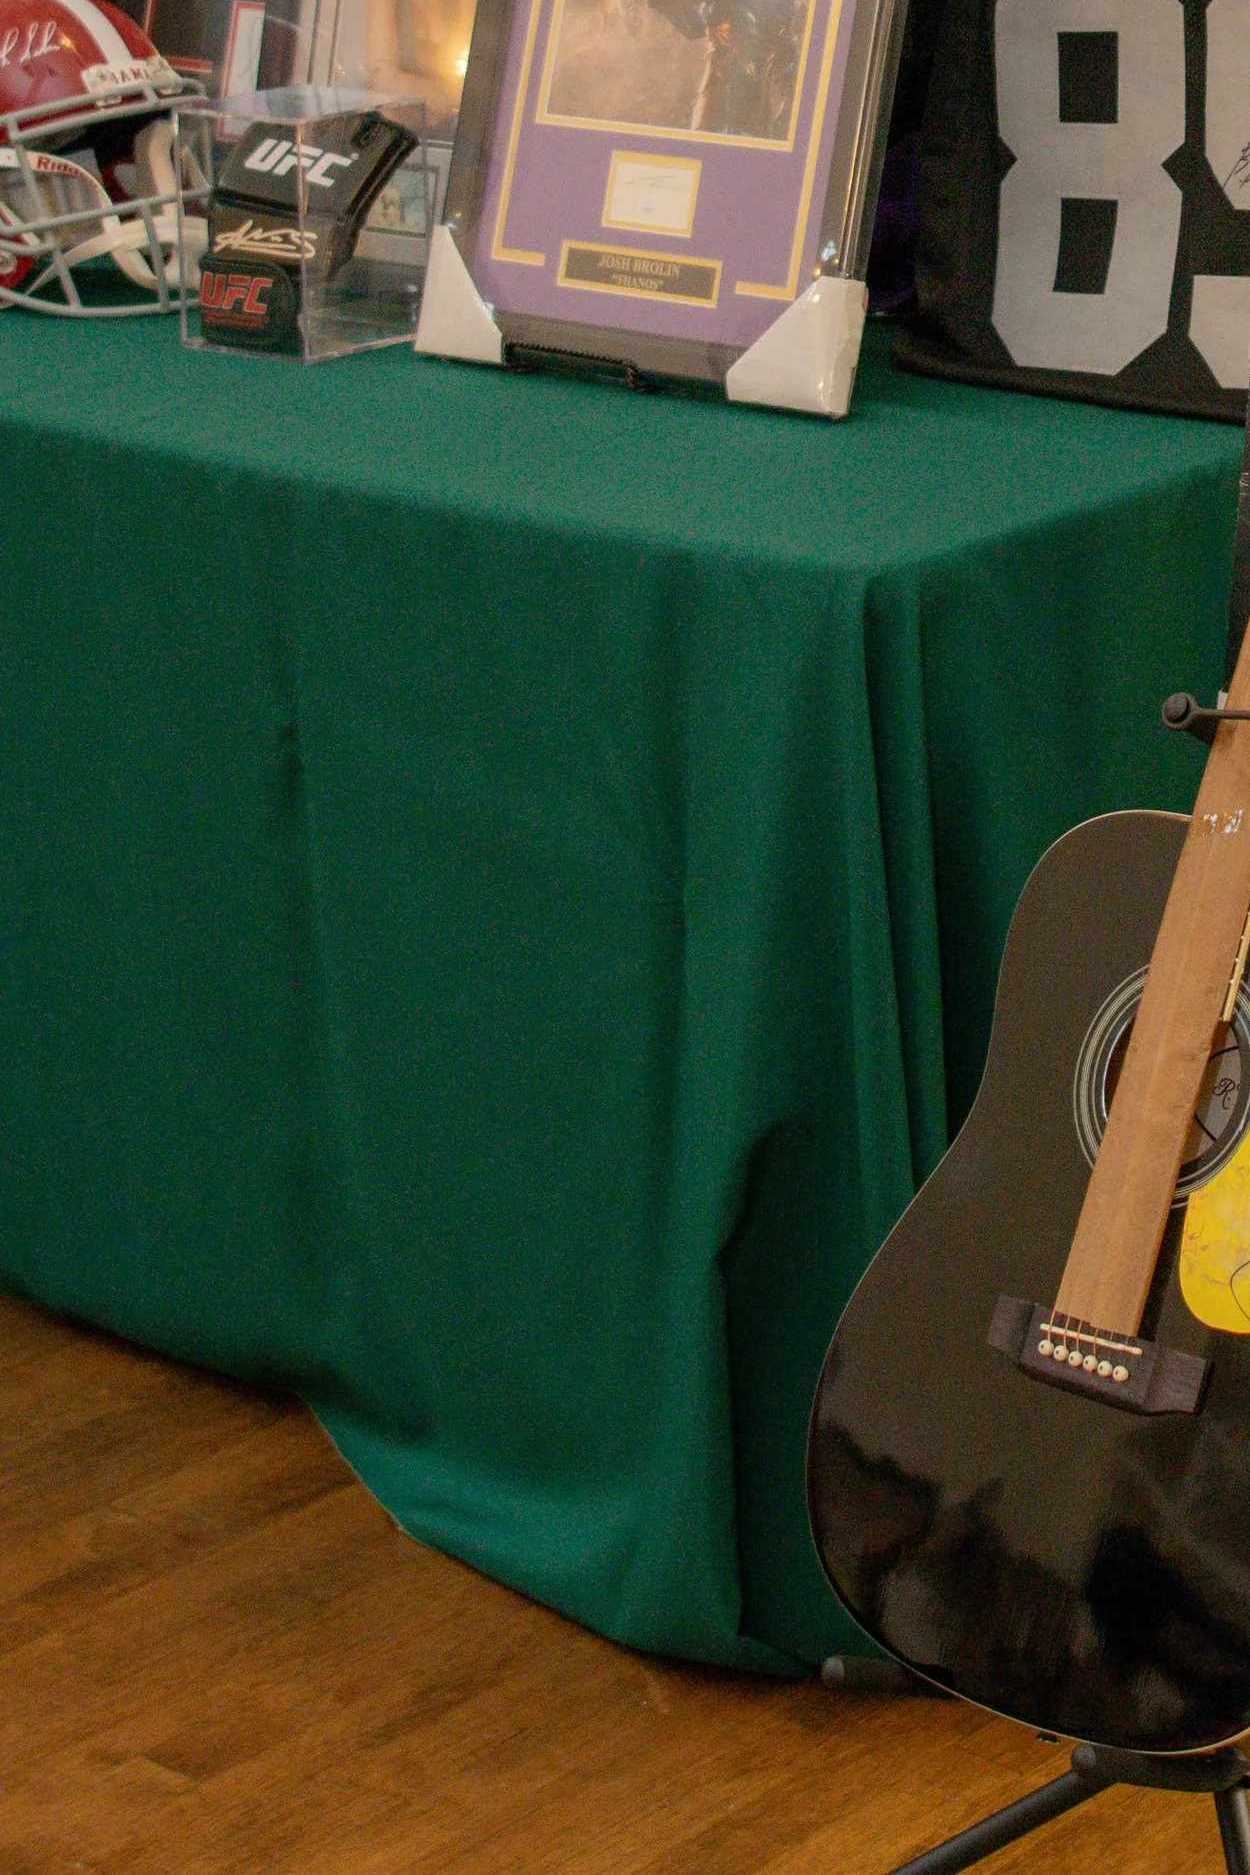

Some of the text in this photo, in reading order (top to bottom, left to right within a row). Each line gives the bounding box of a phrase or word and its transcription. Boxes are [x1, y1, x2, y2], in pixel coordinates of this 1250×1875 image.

[244, 138, 354, 188] UFC
[598, 254, 681, 277] JOSH BROLIN
[200, 271, 273, 315] UFC
